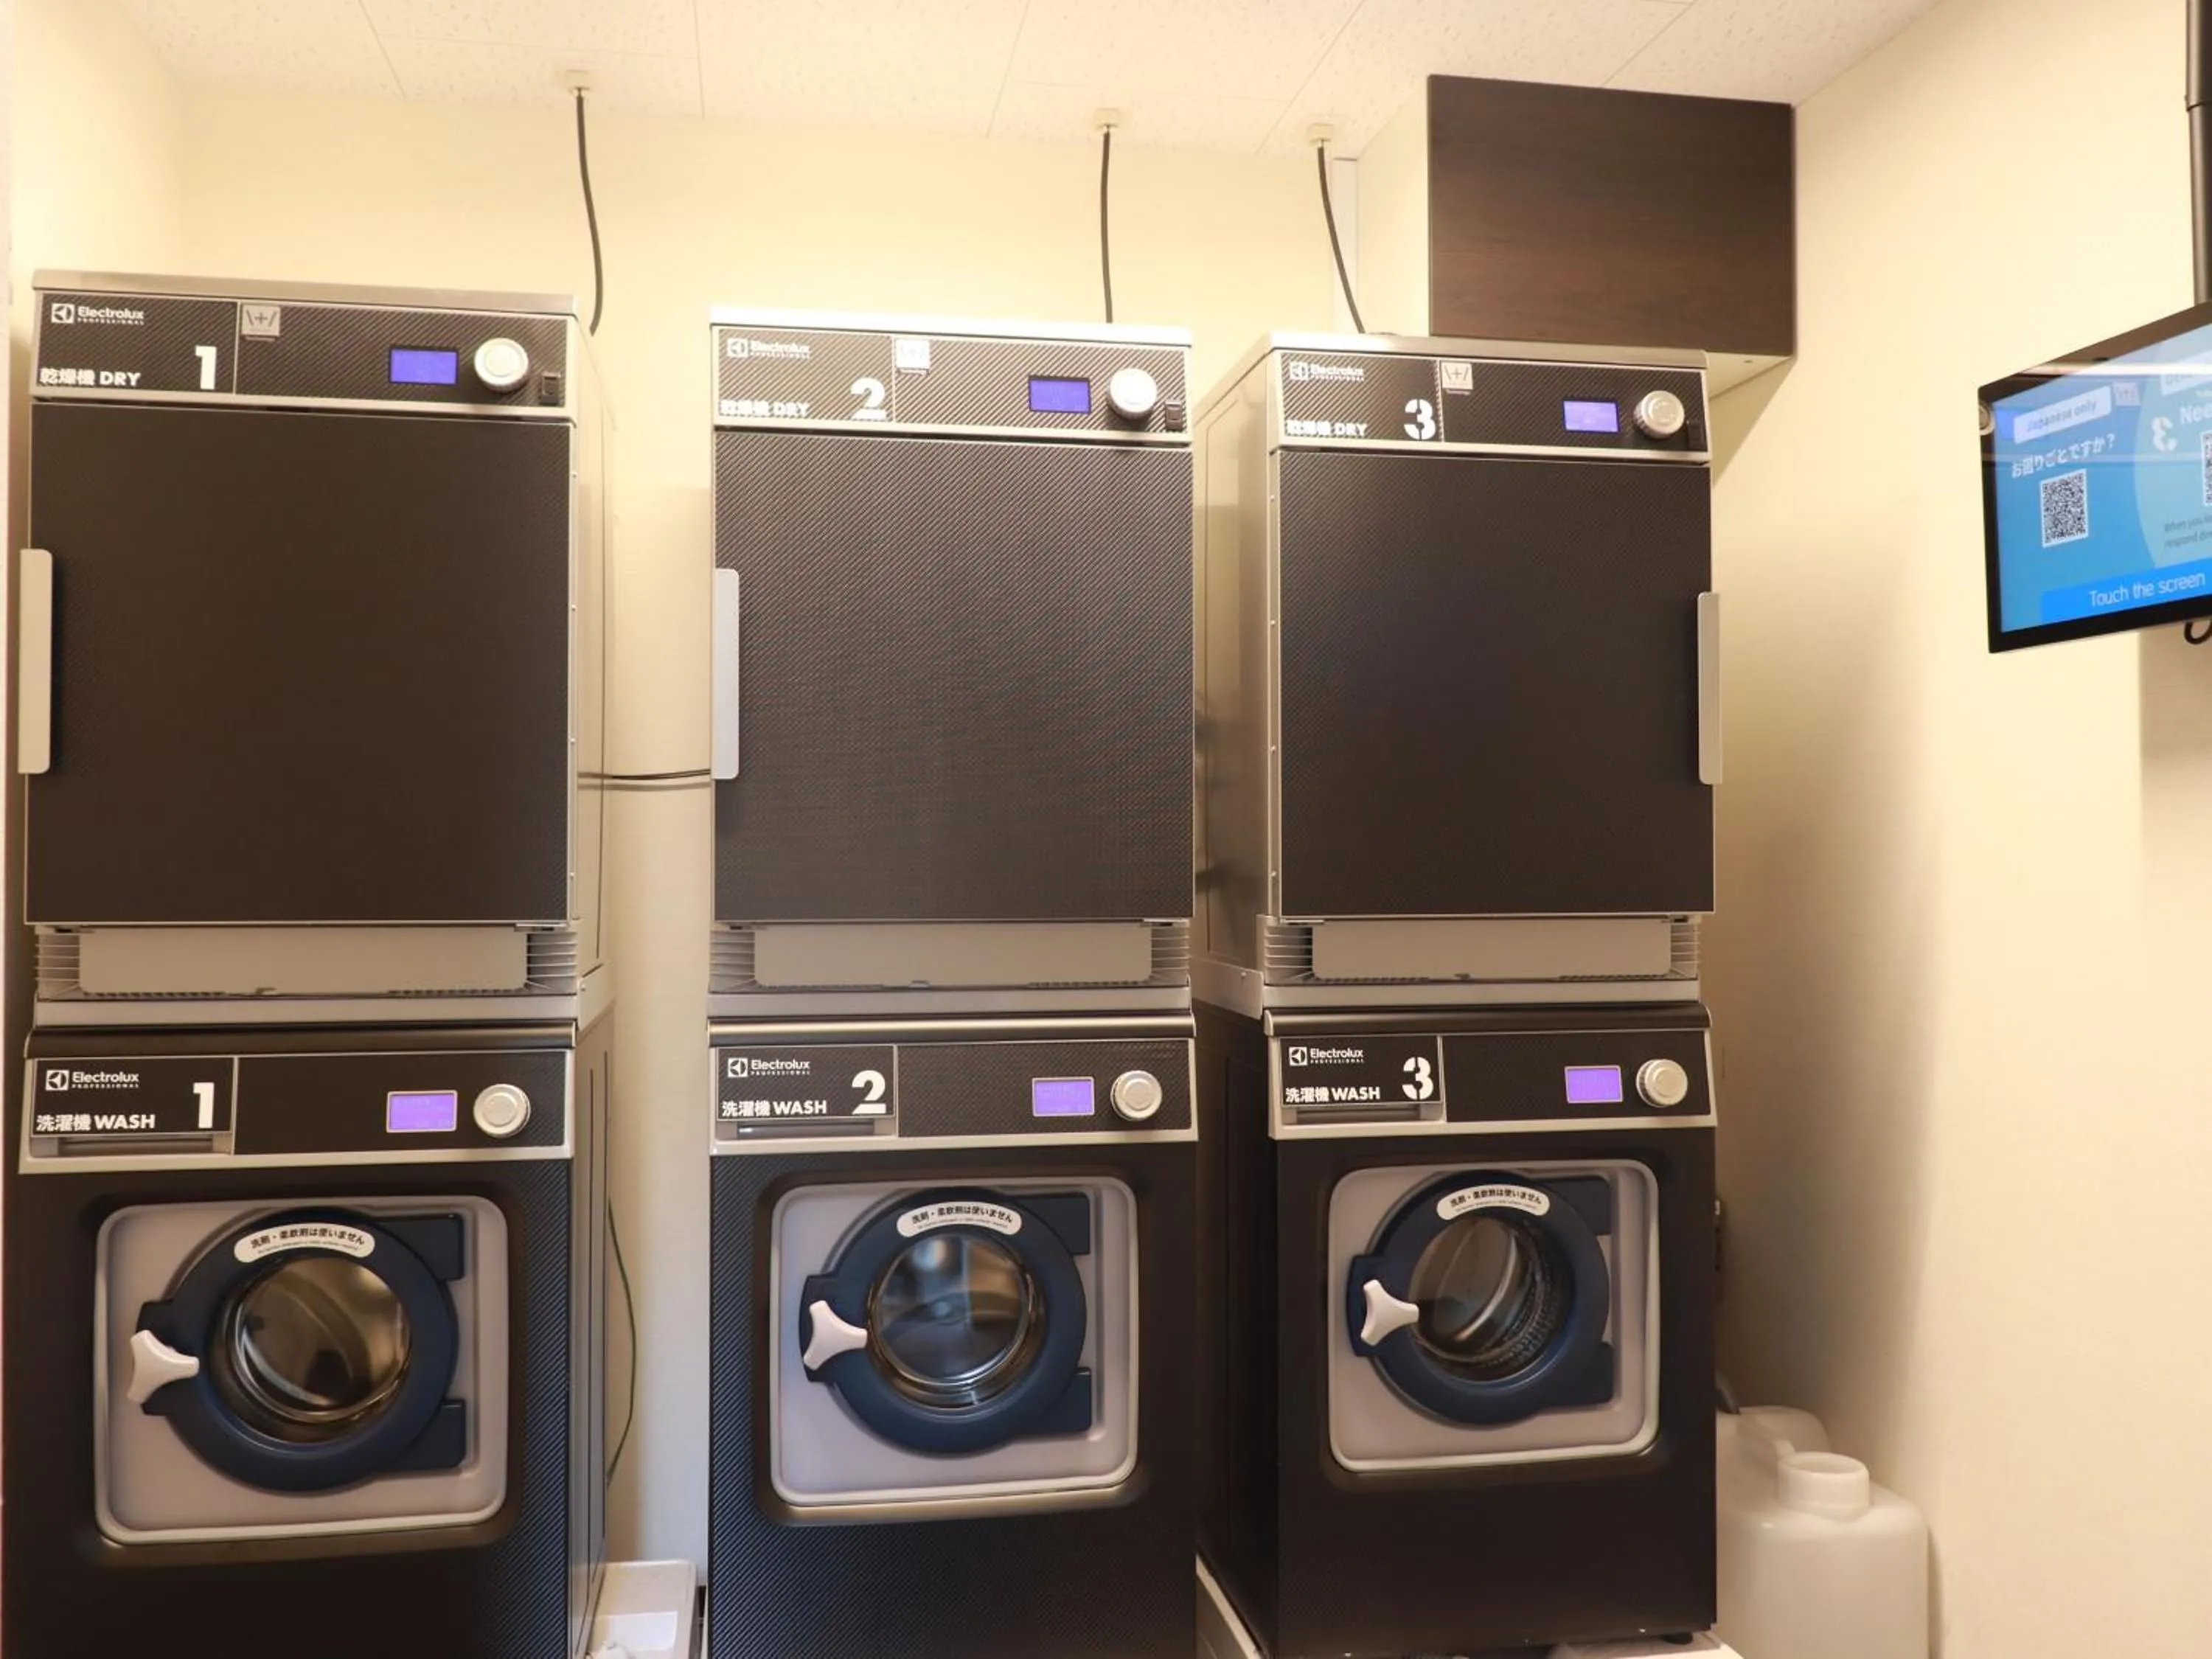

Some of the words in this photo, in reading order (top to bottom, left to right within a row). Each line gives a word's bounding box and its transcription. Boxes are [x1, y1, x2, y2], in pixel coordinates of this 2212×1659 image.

[77, 305, 145, 320] Electrolux
[195, 345, 218, 390] 1
[100, 370, 142, 387] DRY
[850, 377, 886, 421] 2
[2074, 400, 2097, 418] only
[1403, 399, 1436, 441] 3
[1333, 422, 1367, 437] DRY
[2090, 584, 2129, 608] Touch
[2132, 581, 2154, 599] the
[2157, 572, 2206, 594] screen
[1310, 1048, 1364, 1059] Electrolux
[751, 1059, 810, 1070] Electrolux
[72, 1071, 140, 1083] Electrolux
[1402, 1056, 1435, 1101] 3
[851, 1070, 887, 1116] 2
[1285, 1086, 1329, 1104] 洗濯機
[1331, 1086, 1381, 1102] WASH
[192, 1082, 215, 1130] 1
[721, 1099, 771, 1117] 洗濯機
[773, 1099, 827, 1116] WASH
[36, 1113, 91, 1132] 洗濯機
[94, 1113, 156, 1130] WASH
